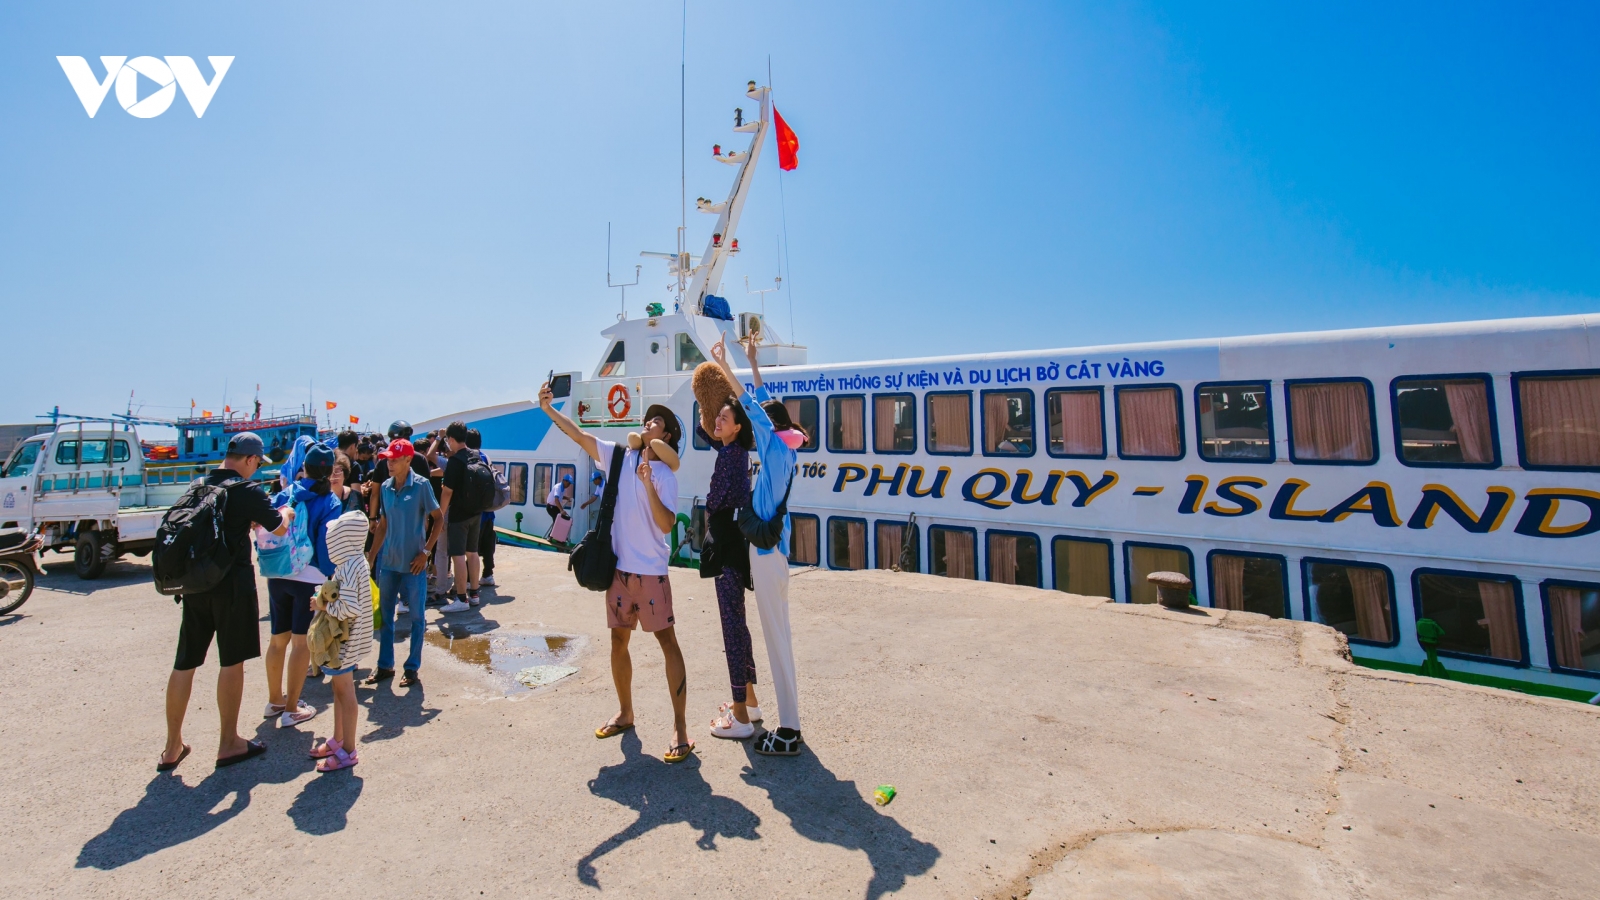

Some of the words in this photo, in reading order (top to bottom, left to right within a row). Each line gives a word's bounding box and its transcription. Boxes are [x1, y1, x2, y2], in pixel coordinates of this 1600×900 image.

[763, 381, 788, 394] NHH
[791, 373, 835, 392] TRUYỀN
[838, 374, 881, 391] THÔNG
[884, 371, 904, 391] SỰ
[907, 370, 939, 390] KIỆN
[943, 367, 964, 386] VÀ
[969, 369, 992, 384] DU
[996, 367, 1031, 386] LỊCH
[1036, 361, 1060, 381] BỜ
[1065, 360, 1102, 380] CÁT
[1106, 357, 1165, 378] VÀNG
[803, 462, 828, 478] TỐC
[832, 462, 952, 499] PHU
[961, 467, 1119, 510] QUY
[1177, 474, 1600, 538] ISLAND
